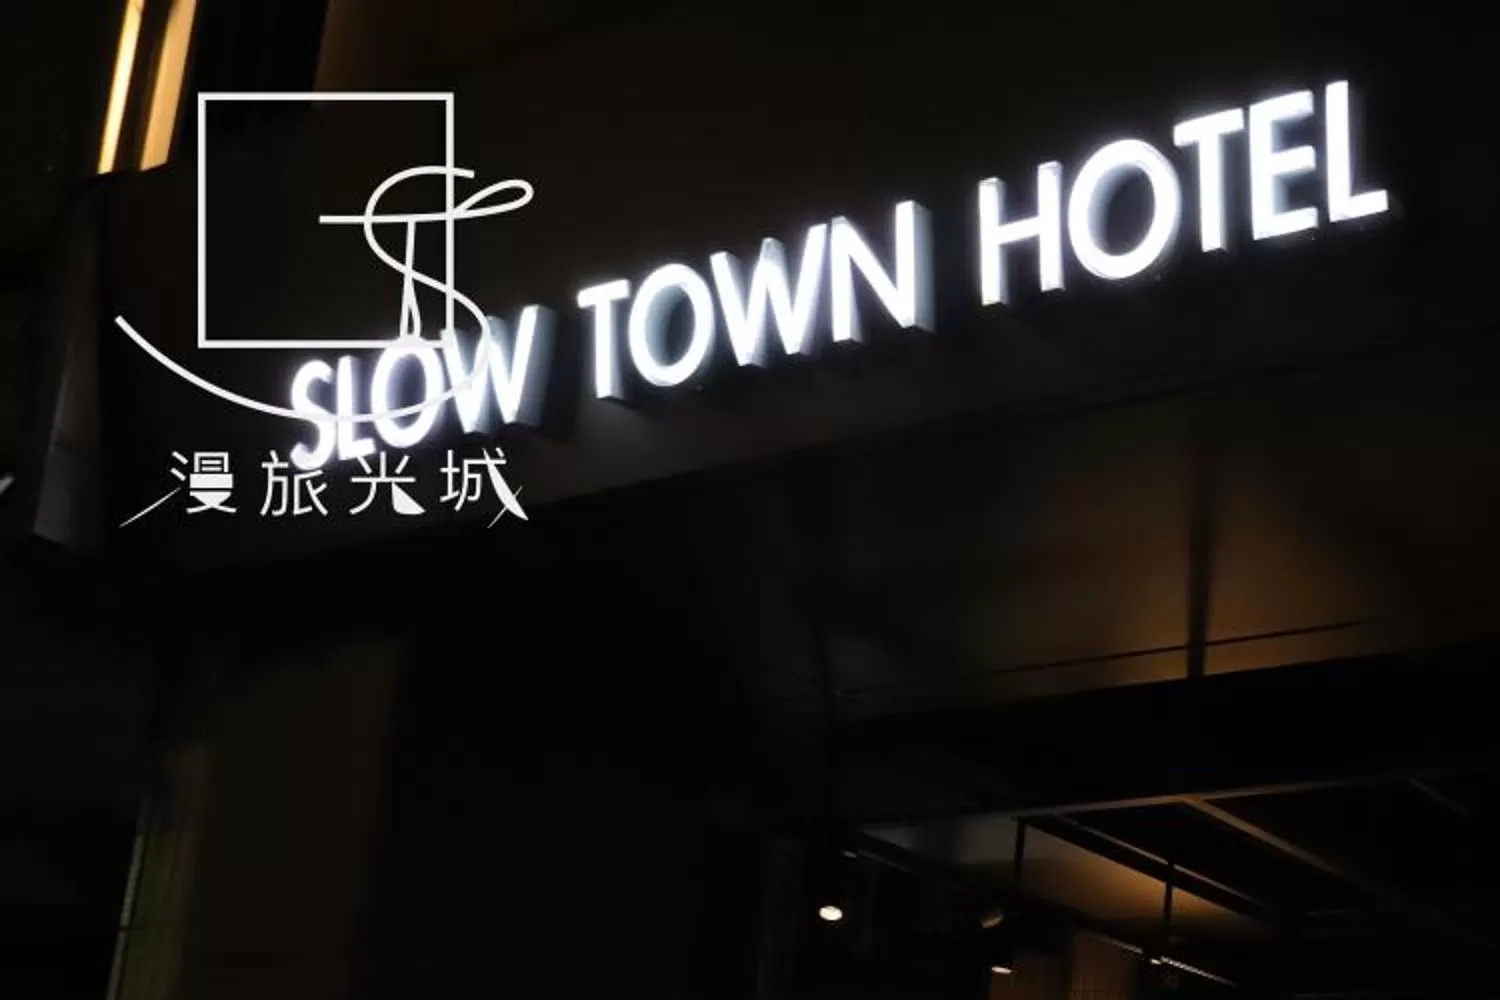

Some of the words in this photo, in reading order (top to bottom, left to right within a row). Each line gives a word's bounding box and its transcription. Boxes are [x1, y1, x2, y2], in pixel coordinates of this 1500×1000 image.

[289, 302, 552, 470] SLOW
[578, 199, 933, 399] TOWN
[978, 79, 1388, 307] HOTEL
